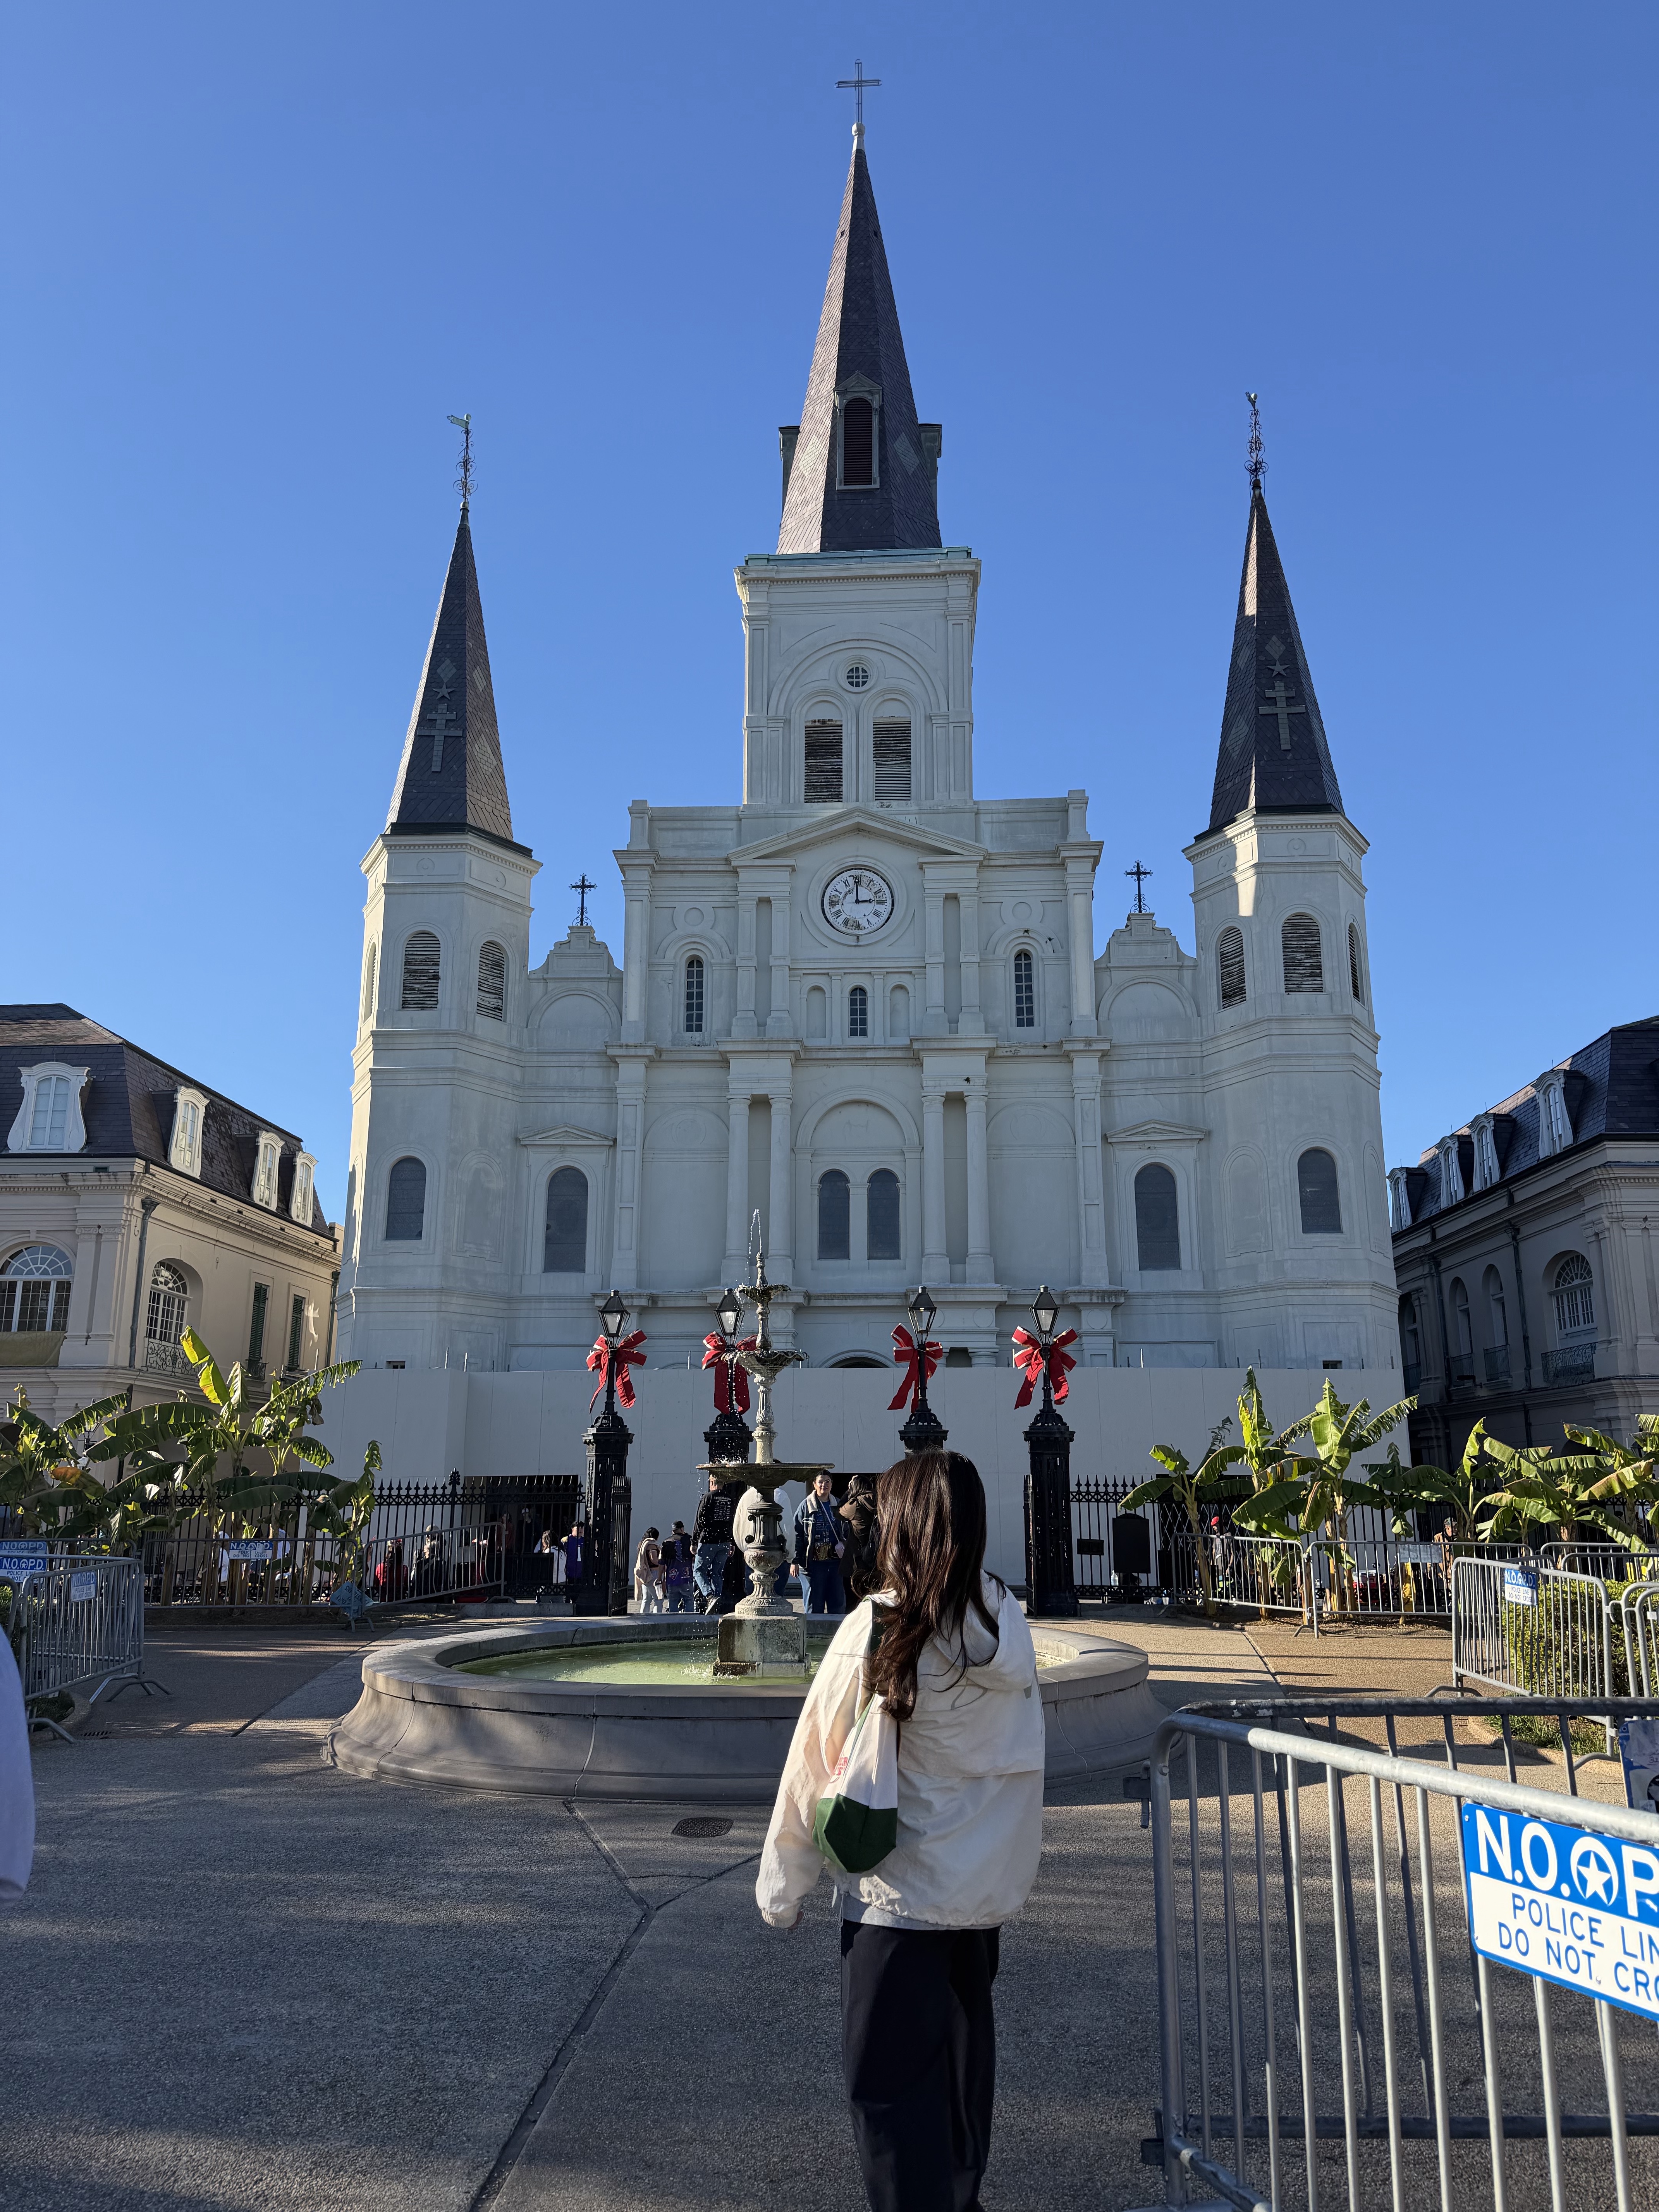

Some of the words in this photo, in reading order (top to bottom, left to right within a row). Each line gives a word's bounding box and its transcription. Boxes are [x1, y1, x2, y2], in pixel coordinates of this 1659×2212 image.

[1512, 1892, 1604, 1948] POLICE
[1498, 1922, 1529, 1957] DO
[1546, 1937, 1595, 1980] NOT
[1614, 1961, 1659, 2002] CR
